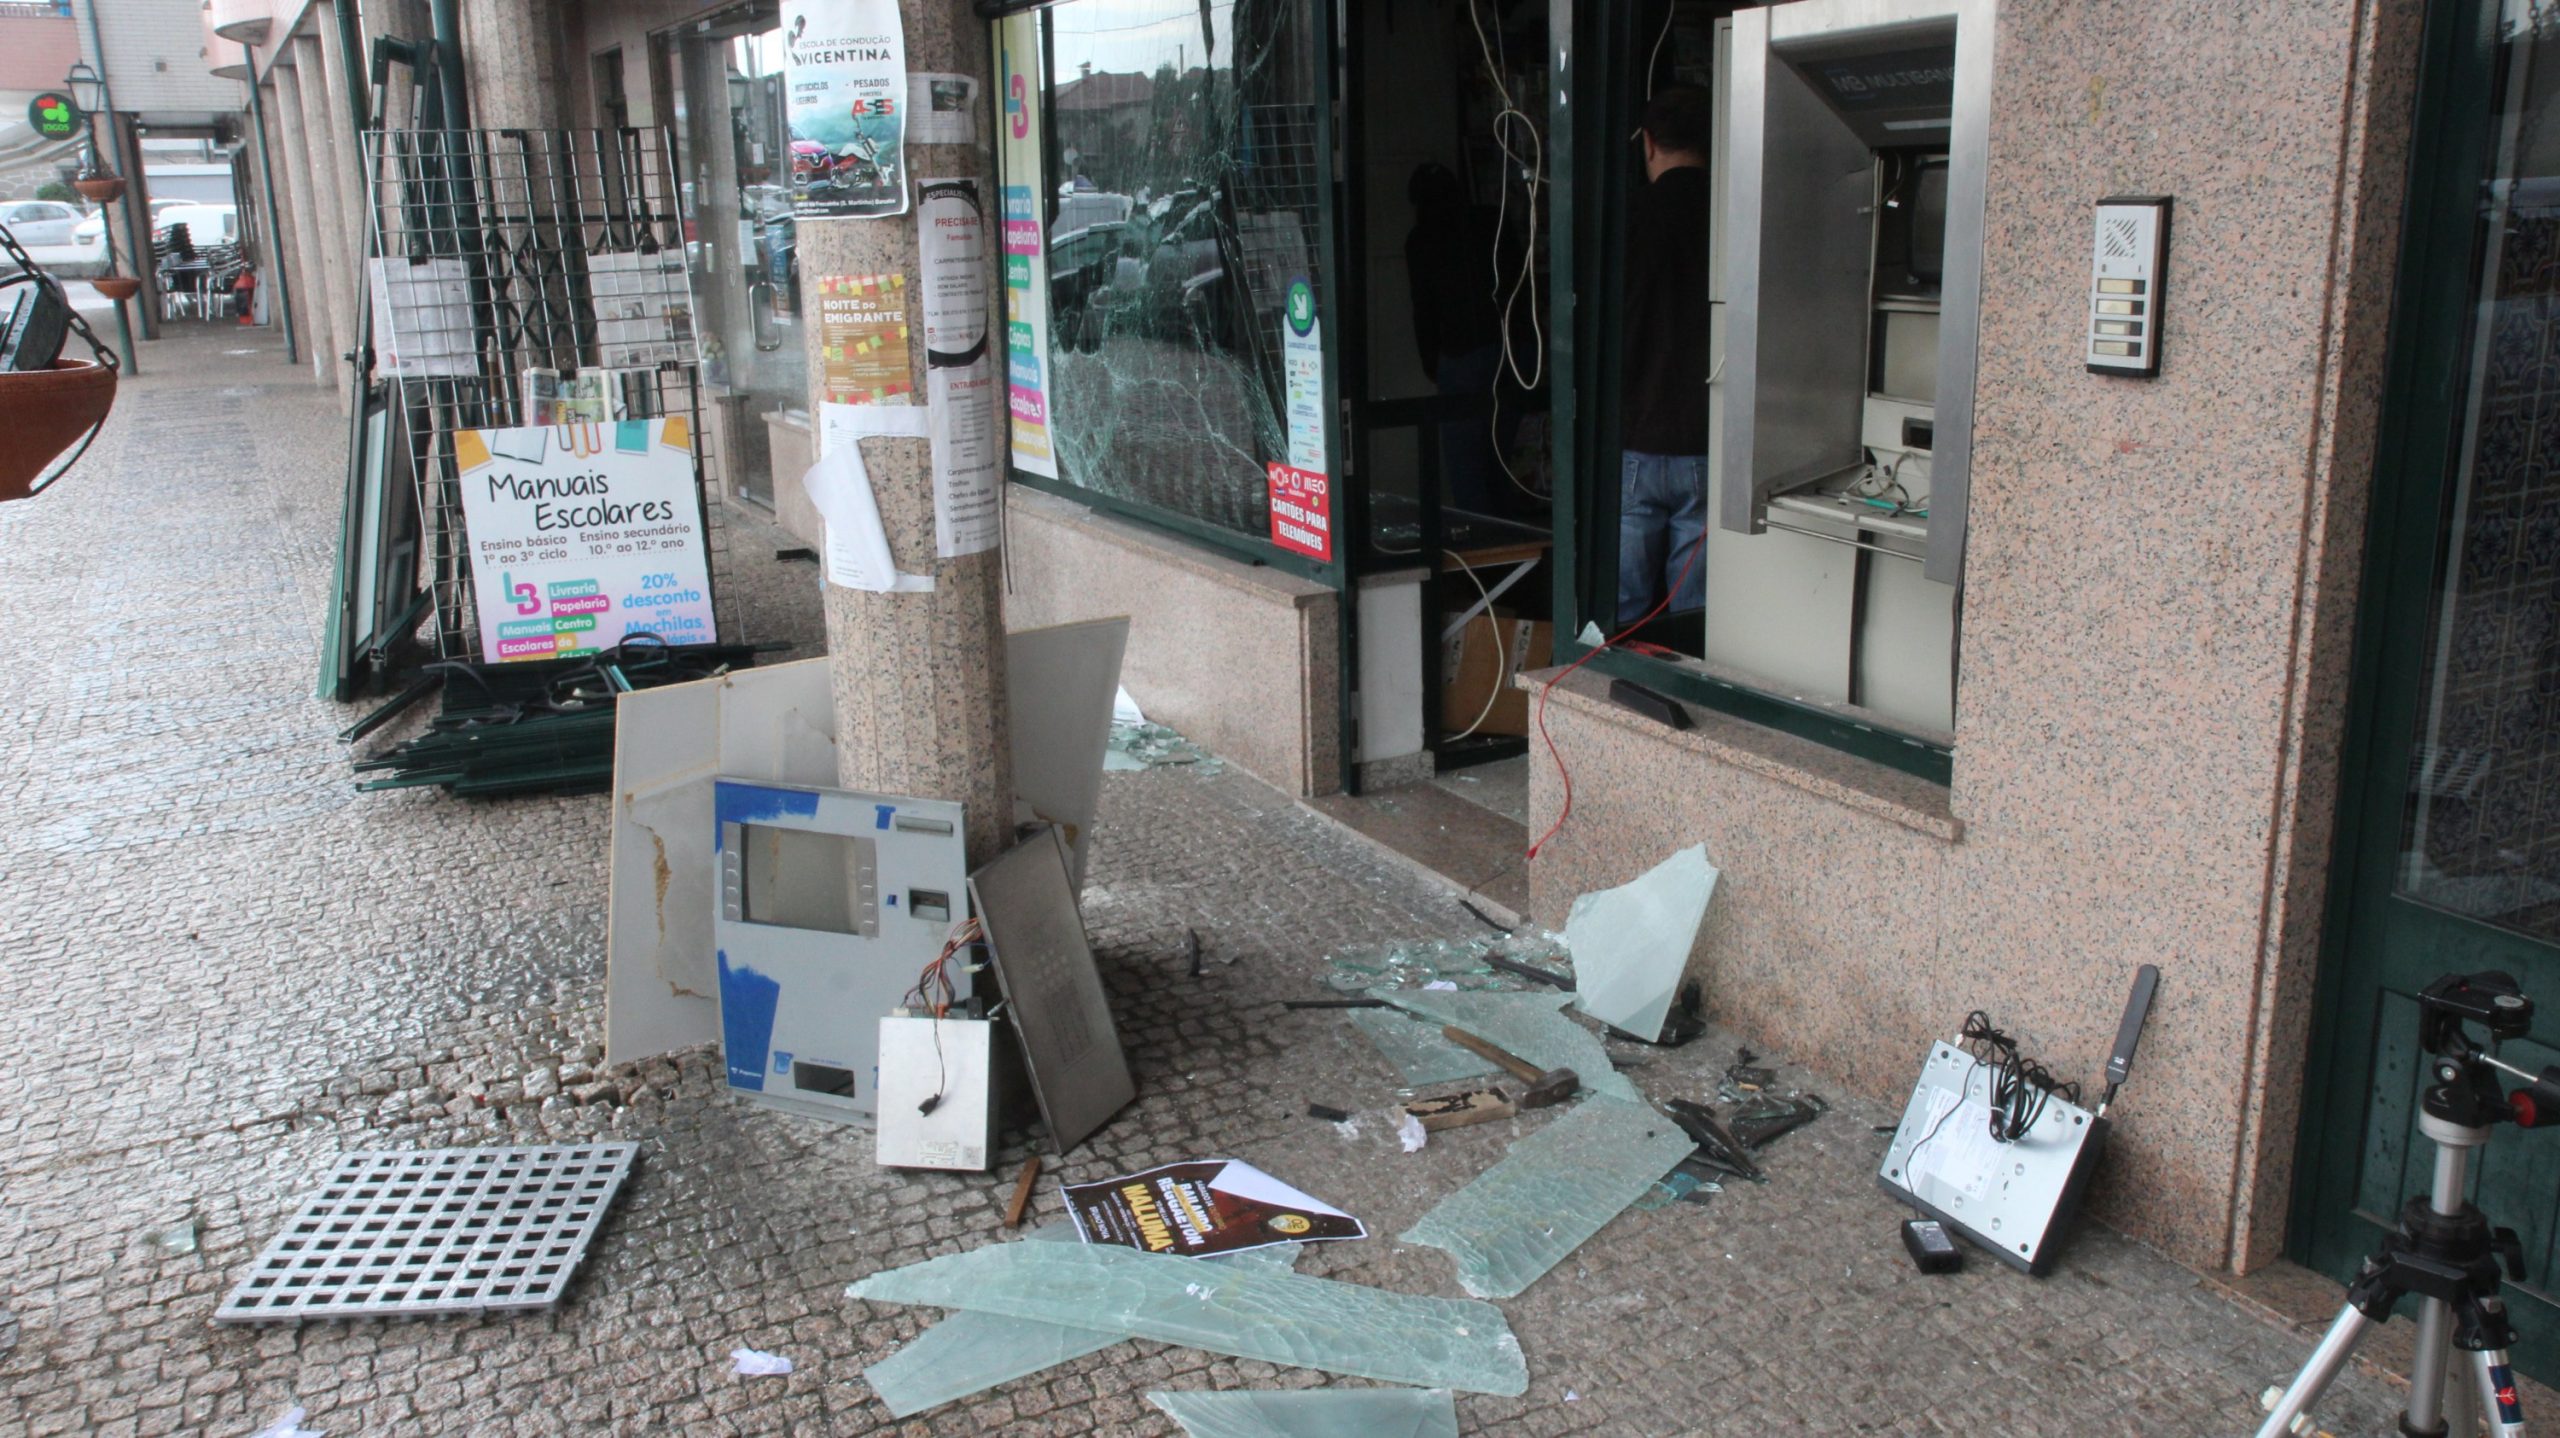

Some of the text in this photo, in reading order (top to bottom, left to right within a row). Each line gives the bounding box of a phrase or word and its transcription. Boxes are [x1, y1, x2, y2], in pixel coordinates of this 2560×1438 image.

[826, 39, 838, 47] DE
[839, 35, 892, 46] CONDUÇÃO
[800, 49, 891, 65] VICENTINA
[853, 78, 890, 88] PESADOS
[823, 299, 877, 311] NOITE DO
[824, 311, 903, 324] EMIGRANTE
[1270, 466, 1289, 488] NOS
[488, 469, 609, 503] Manuais
[1303, 476, 1326, 495] MEO
[535, 498, 673, 531] Escolares
[1272, 498, 1327, 532] CARTÕES PARA
[579, 523, 691, 543] Ensino secundário
[1277, 520, 1323, 552] TELEMÓVEIS
[481, 534, 567, 551] Ensino básico
[616, 544, 632, 553] ao
[661, 538, 684, 549] ano
[500, 554, 516, 564] ao
[539, 548, 567, 560] ciclo
[641, 573, 678, 589] 20%
[550, 583, 597, 597] Livraria
[552, 598, 607, 613] Papelaria
[622, 589, 701, 608] desconto
[502, 622, 551, 637] Manuais
[555, 618, 593, 631] Centro
[501, 639, 554, 654] Escolares
[558, 637, 573, 648] de
[1156, 1176, 1204, 1245] REGGAETON
[1179, 1182, 1213, 1231] BAILANDO
[1120, 1183, 1173, 1251] MALUMA
